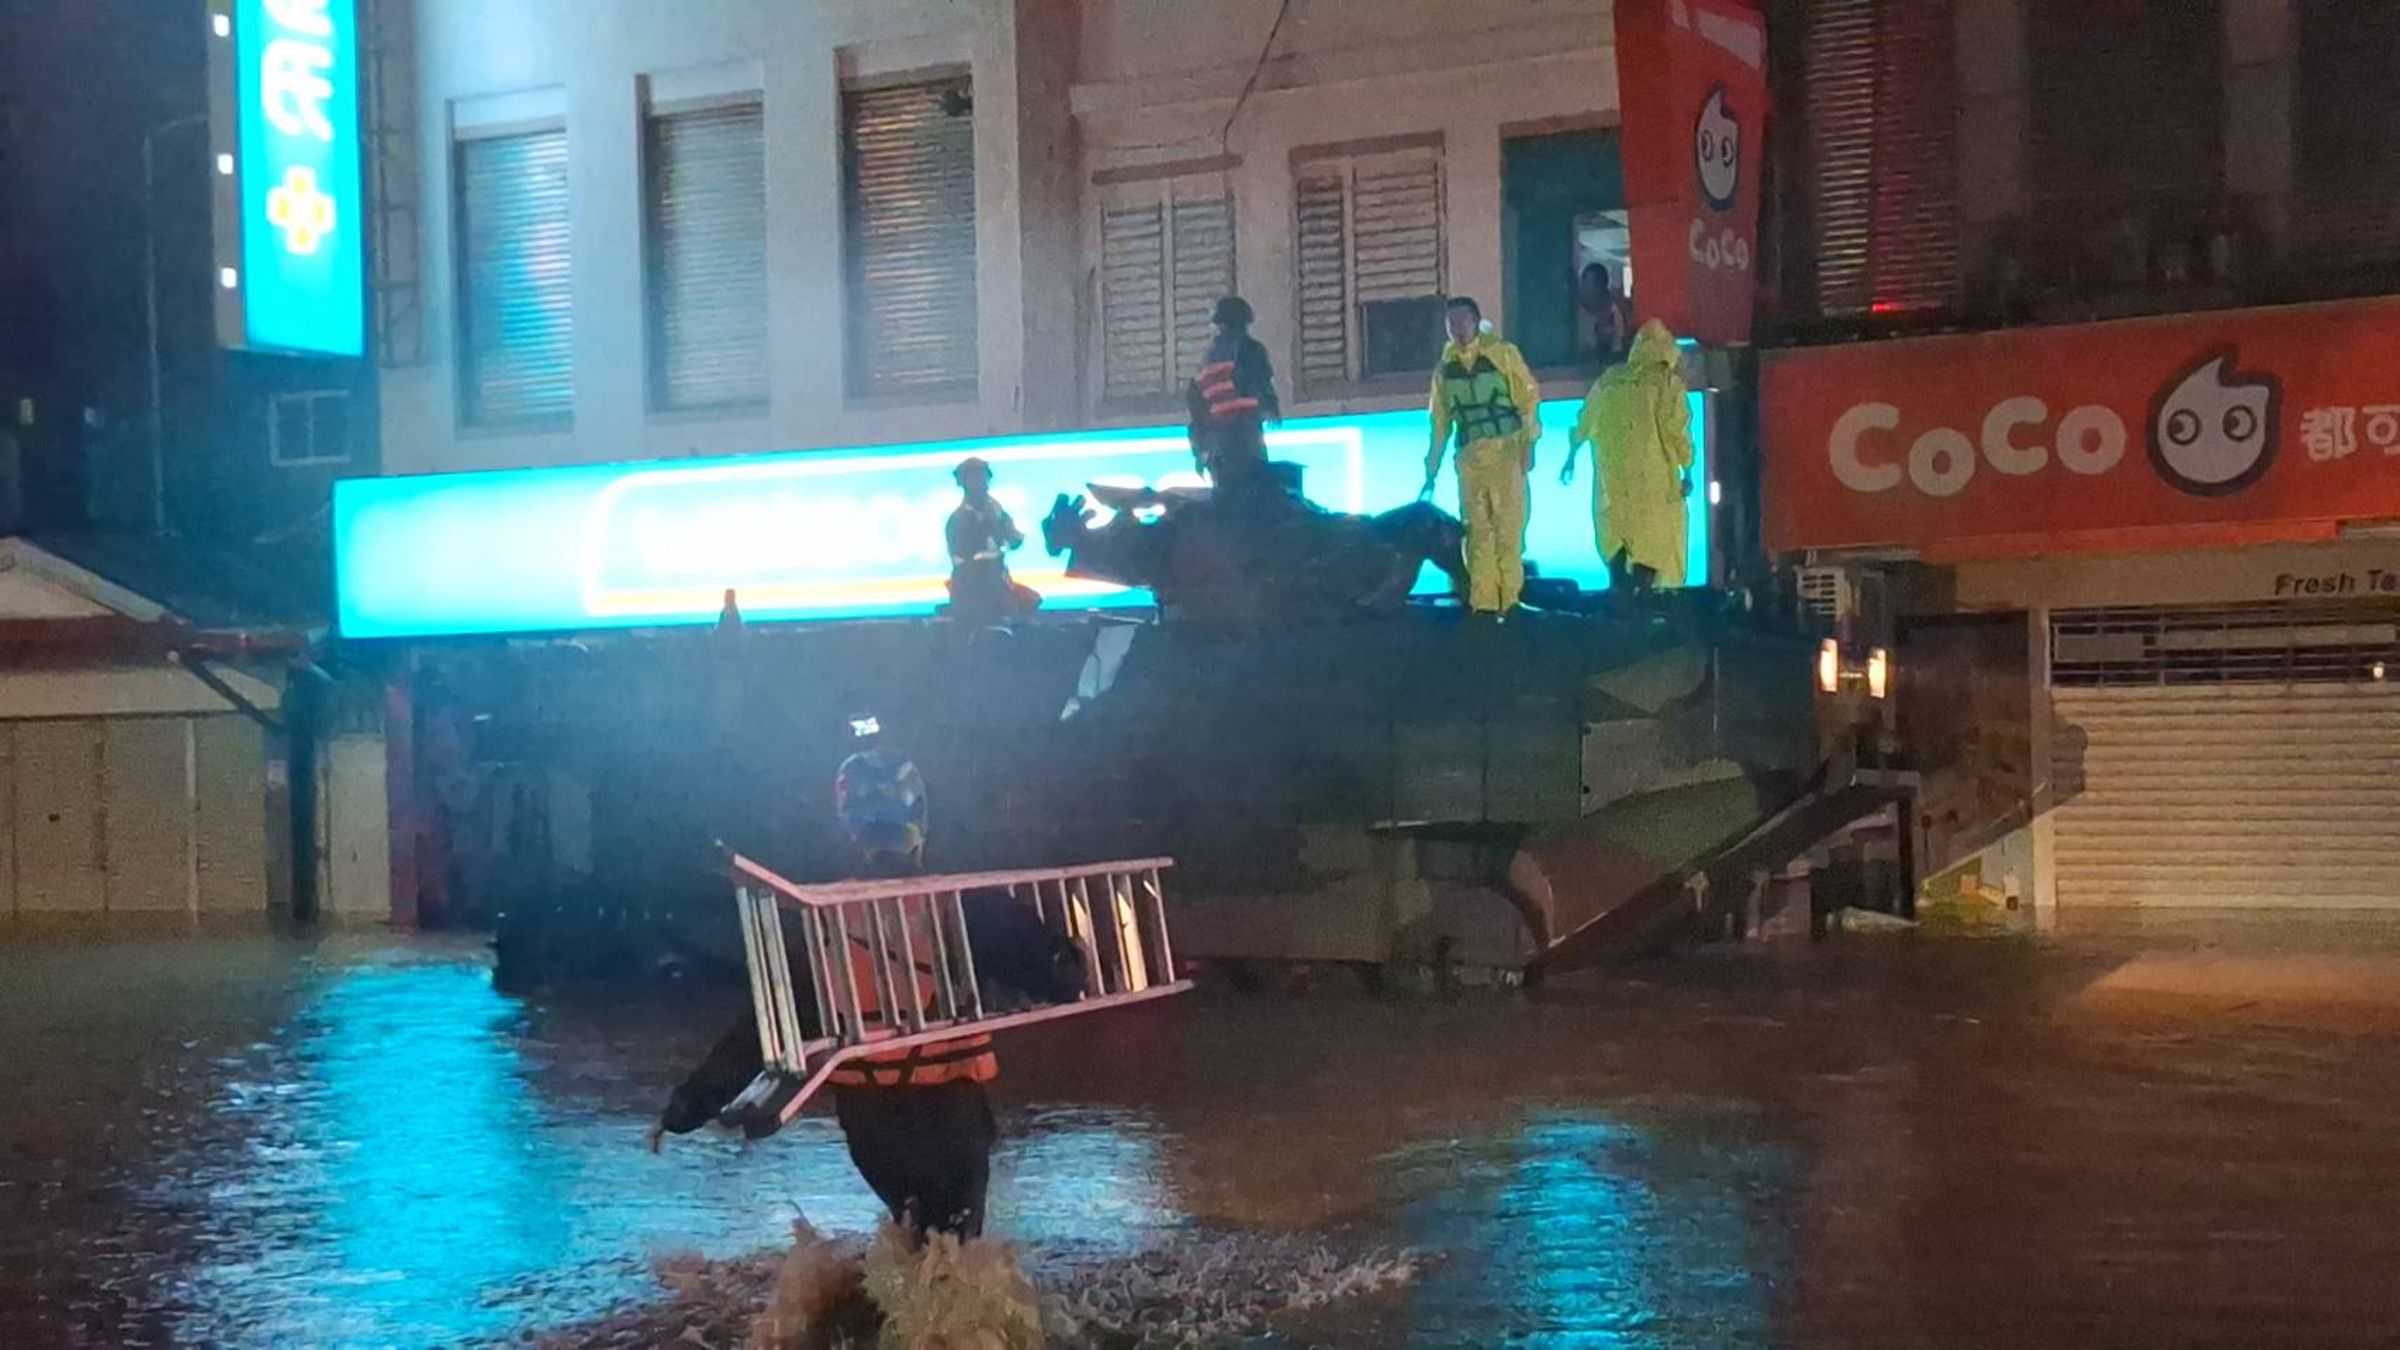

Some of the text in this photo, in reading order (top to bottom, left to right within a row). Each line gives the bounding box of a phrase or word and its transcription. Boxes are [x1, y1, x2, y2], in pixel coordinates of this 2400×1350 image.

[1688, 217, 1749, 271] CoCo
[1829, 396, 2127, 497] CoCo
[2275, 571, 2355, 596] Fresh
